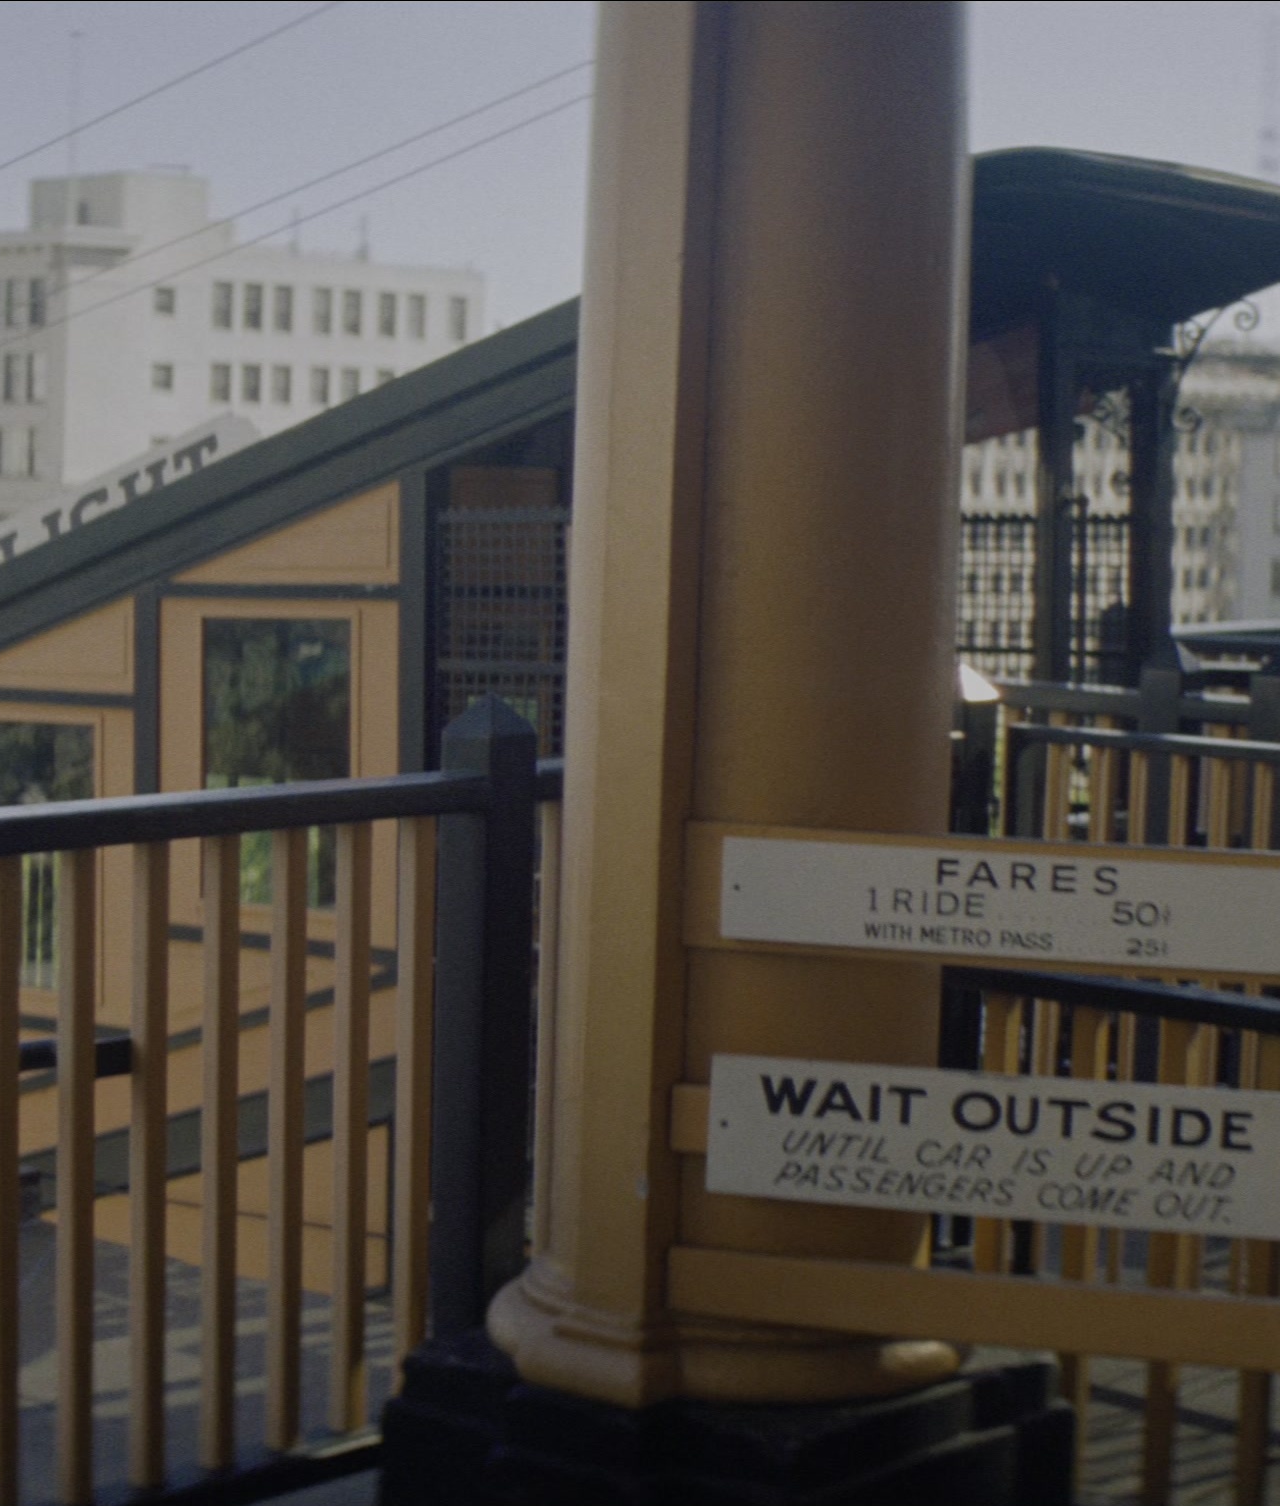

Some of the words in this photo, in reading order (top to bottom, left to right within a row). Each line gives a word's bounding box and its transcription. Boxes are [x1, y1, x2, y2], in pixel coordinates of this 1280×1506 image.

[935, 858, 1120, 895] FARES
[868, 887, 878, 912] 1
[892, 888, 986, 918] RIDE
[864, 922, 912, 942] WITH
[920, 925, 992, 947] METRO
[1000, 930, 1054, 952] PASS
[759, 1073, 927, 1126] WAIT
[952, 1091, 1254, 1152] OUTSIDE
[780, 1130, 891, 1164] UNTIL
[915, 1139, 992, 1170] CAR
[1012, 1147, 1053, 1177] IS
[1075, 1151, 1134, 1181] UP
[1149, 1160, 1237, 1190] AND
[773, 1162, 1015, 1209] PASSENGERS
[1036, 1182, 1138, 1217] COME
[1153, 1191, 1232, 1225] OUT.
